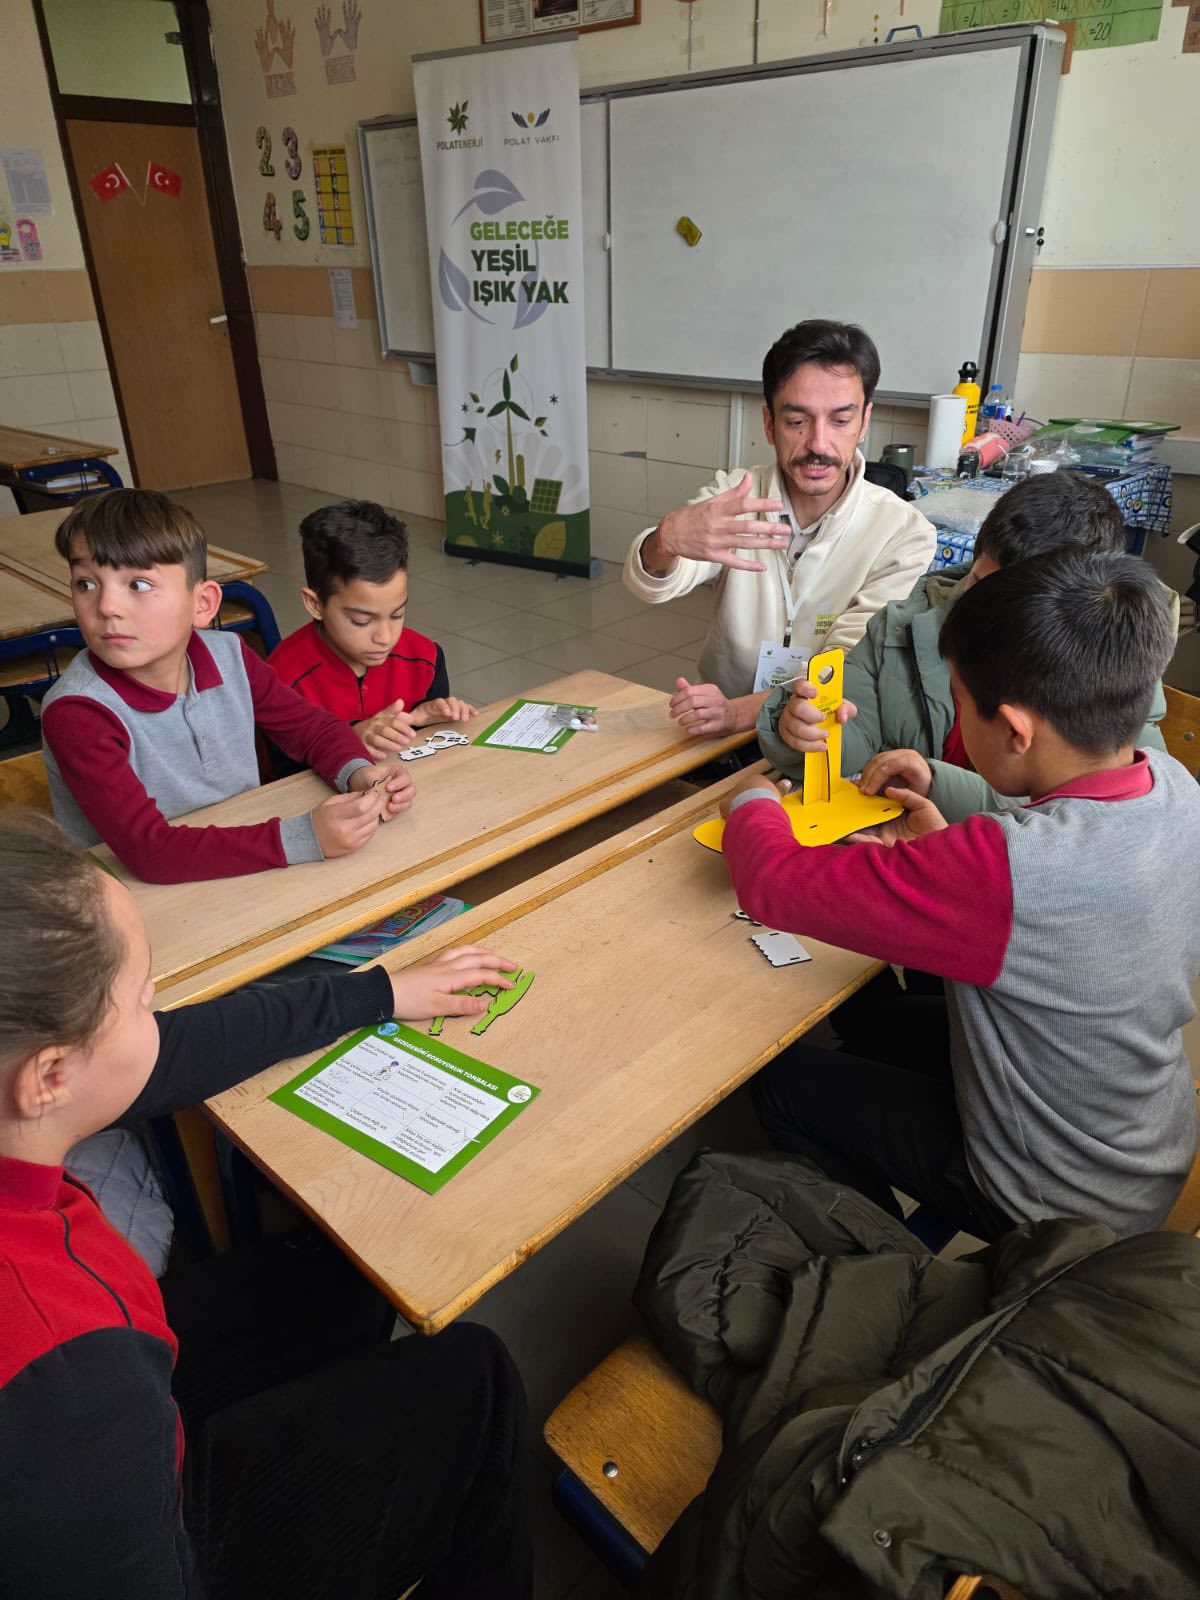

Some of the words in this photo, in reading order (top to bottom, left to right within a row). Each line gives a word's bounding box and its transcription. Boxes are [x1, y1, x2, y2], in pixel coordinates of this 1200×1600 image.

[256, 126, 276, 177] 2
[282, 126, 302, 180] 3
[503, 137, 531, 147] POLAT
[263, 191, 282, 241] 4
[292, 189, 310, 241] 5
[470, 214, 569, 241] GELECEĞE
[471, 243, 537, 277] YEŞİL
[473, 280, 516, 307] IŞIK
[520, 279, 569, 304] YAK
